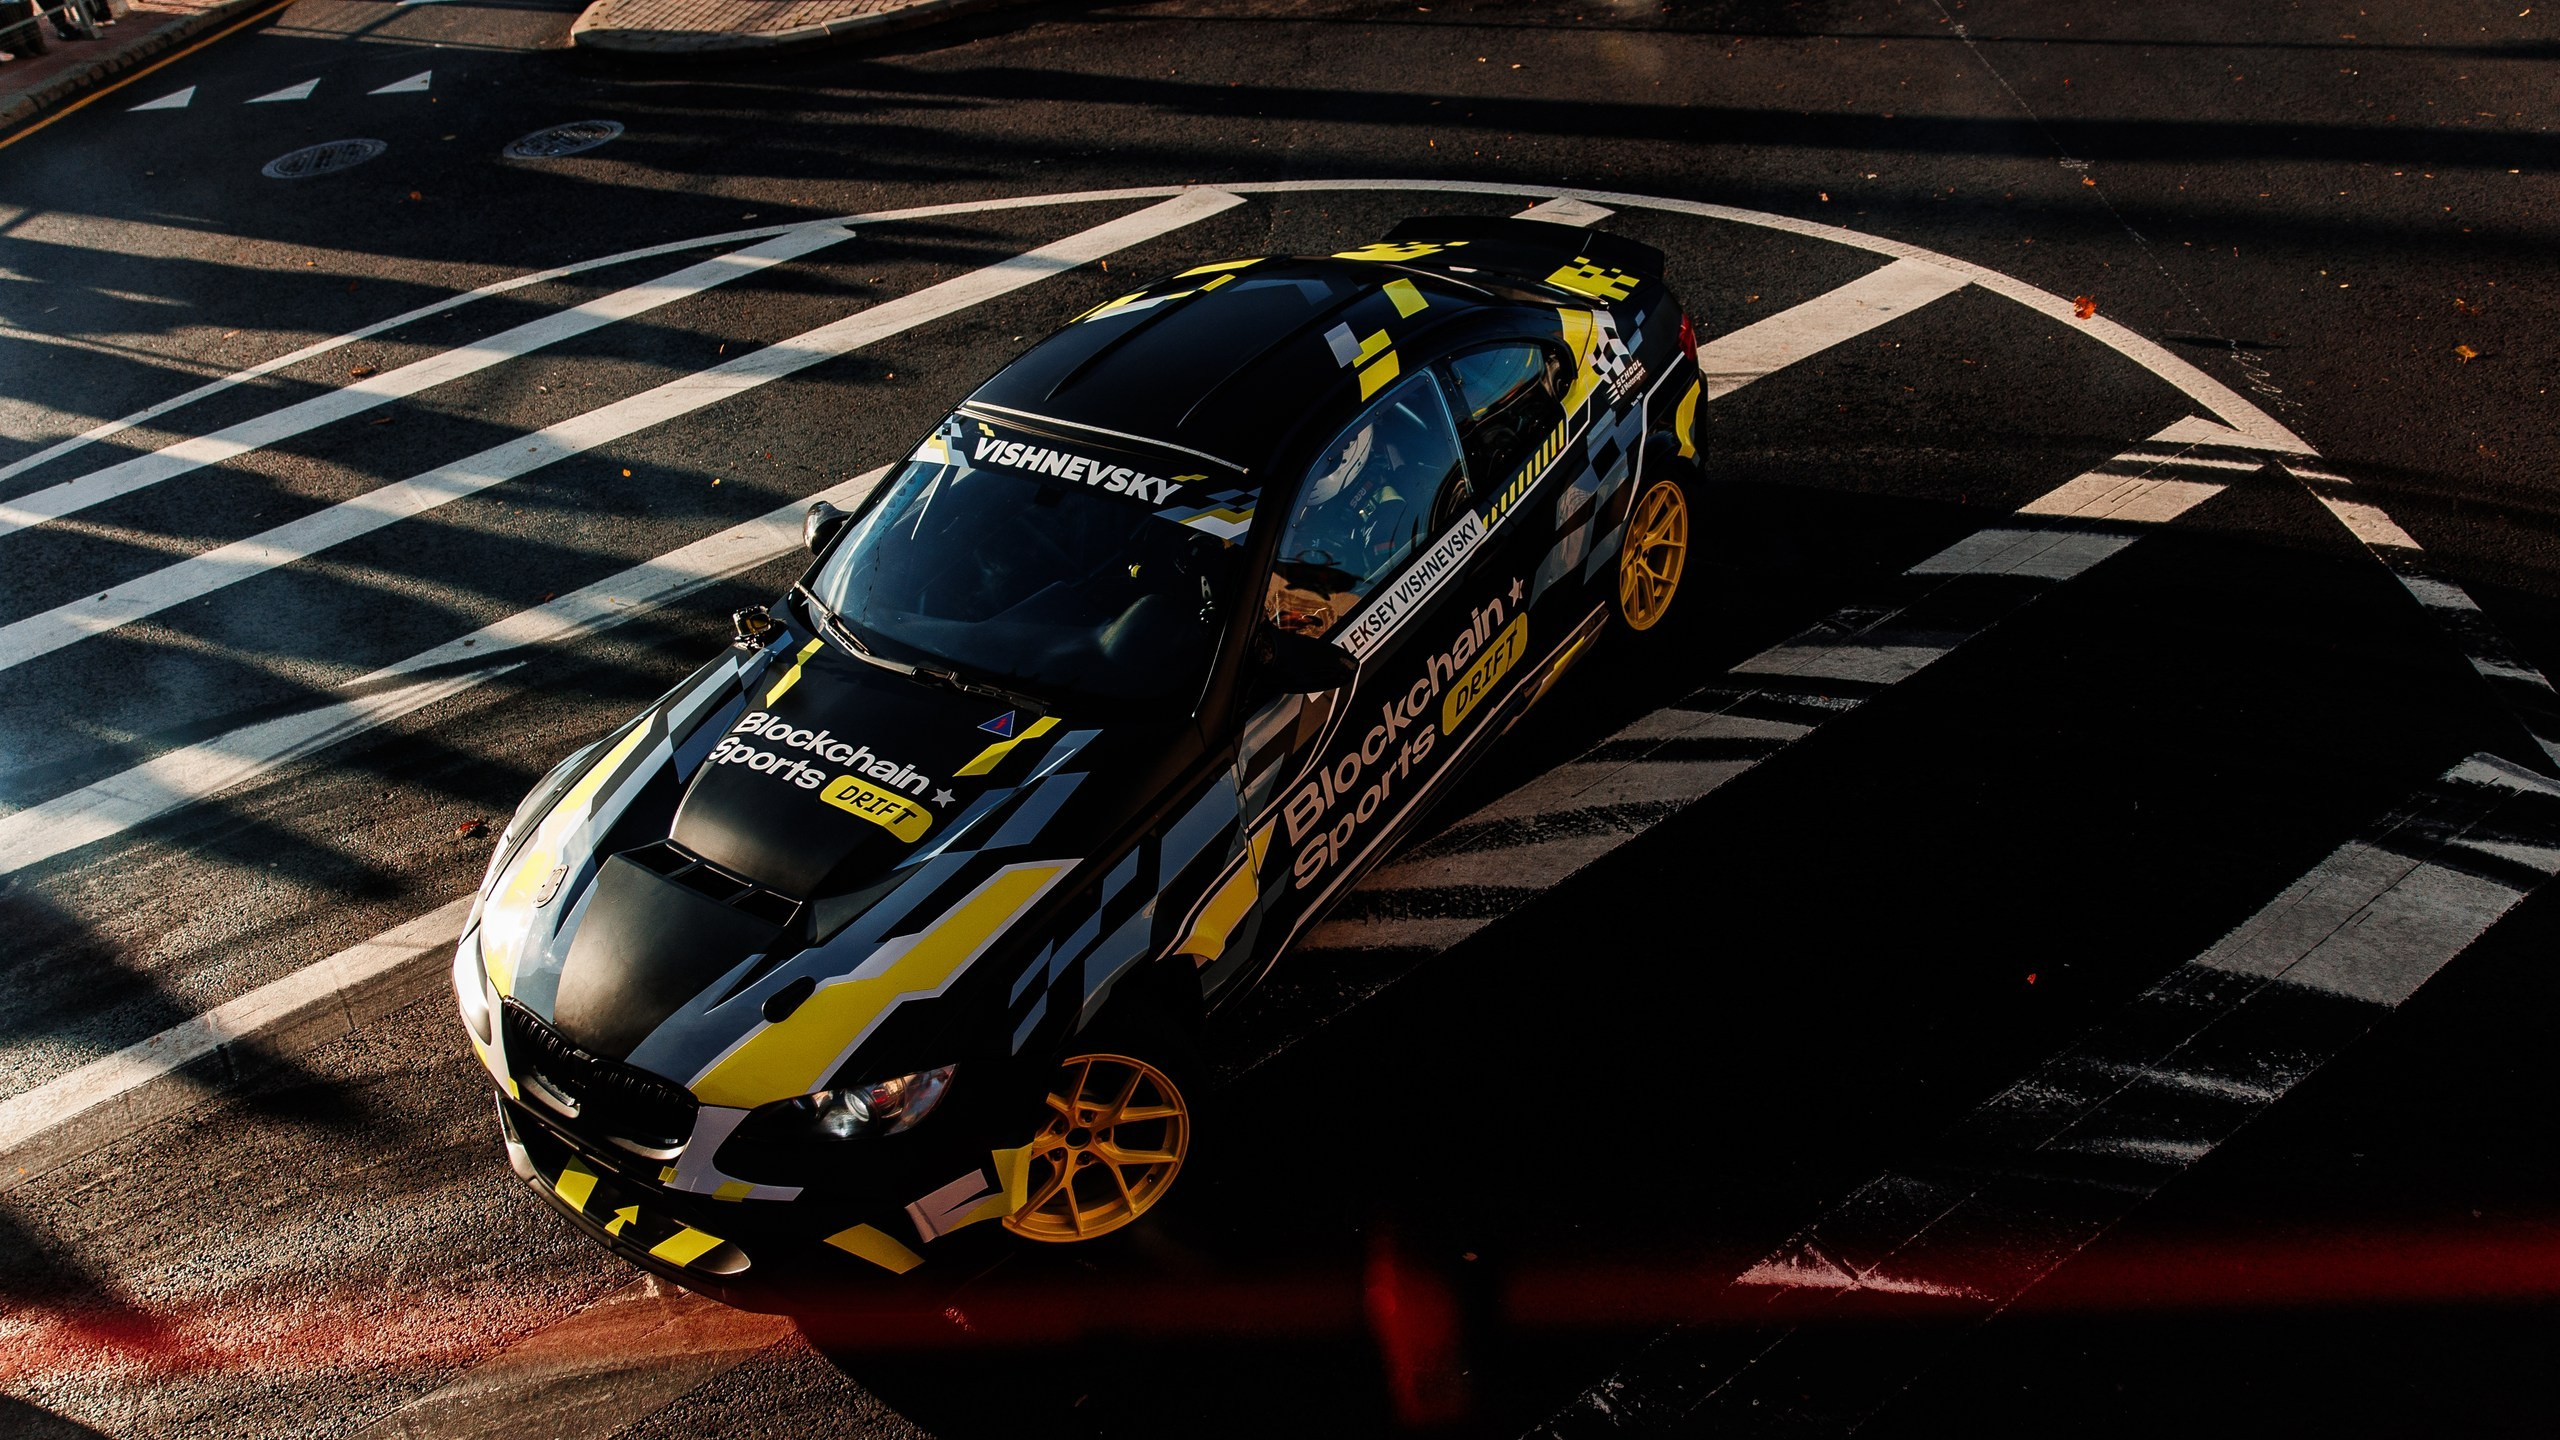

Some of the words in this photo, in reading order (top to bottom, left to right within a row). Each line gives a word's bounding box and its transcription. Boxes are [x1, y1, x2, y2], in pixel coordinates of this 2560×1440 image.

[1616, 360, 1642, 388] SCHOOL
[973, 437, 1183, 505] VISHNEVSKY
[1340, 596, 1398, 655] LEKSEY
[1394, 518, 1478, 604] VISHNEVSKY
[732, 711, 930, 796] Blockchain
[1283, 598, 1504, 847] Blockchain
[1294, 724, 1435, 890] Sports
[1455, 629, 1518, 717] DRIFT
[708, 736, 826, 789] Sports
[835, 785, 918, 825] DRIFT
